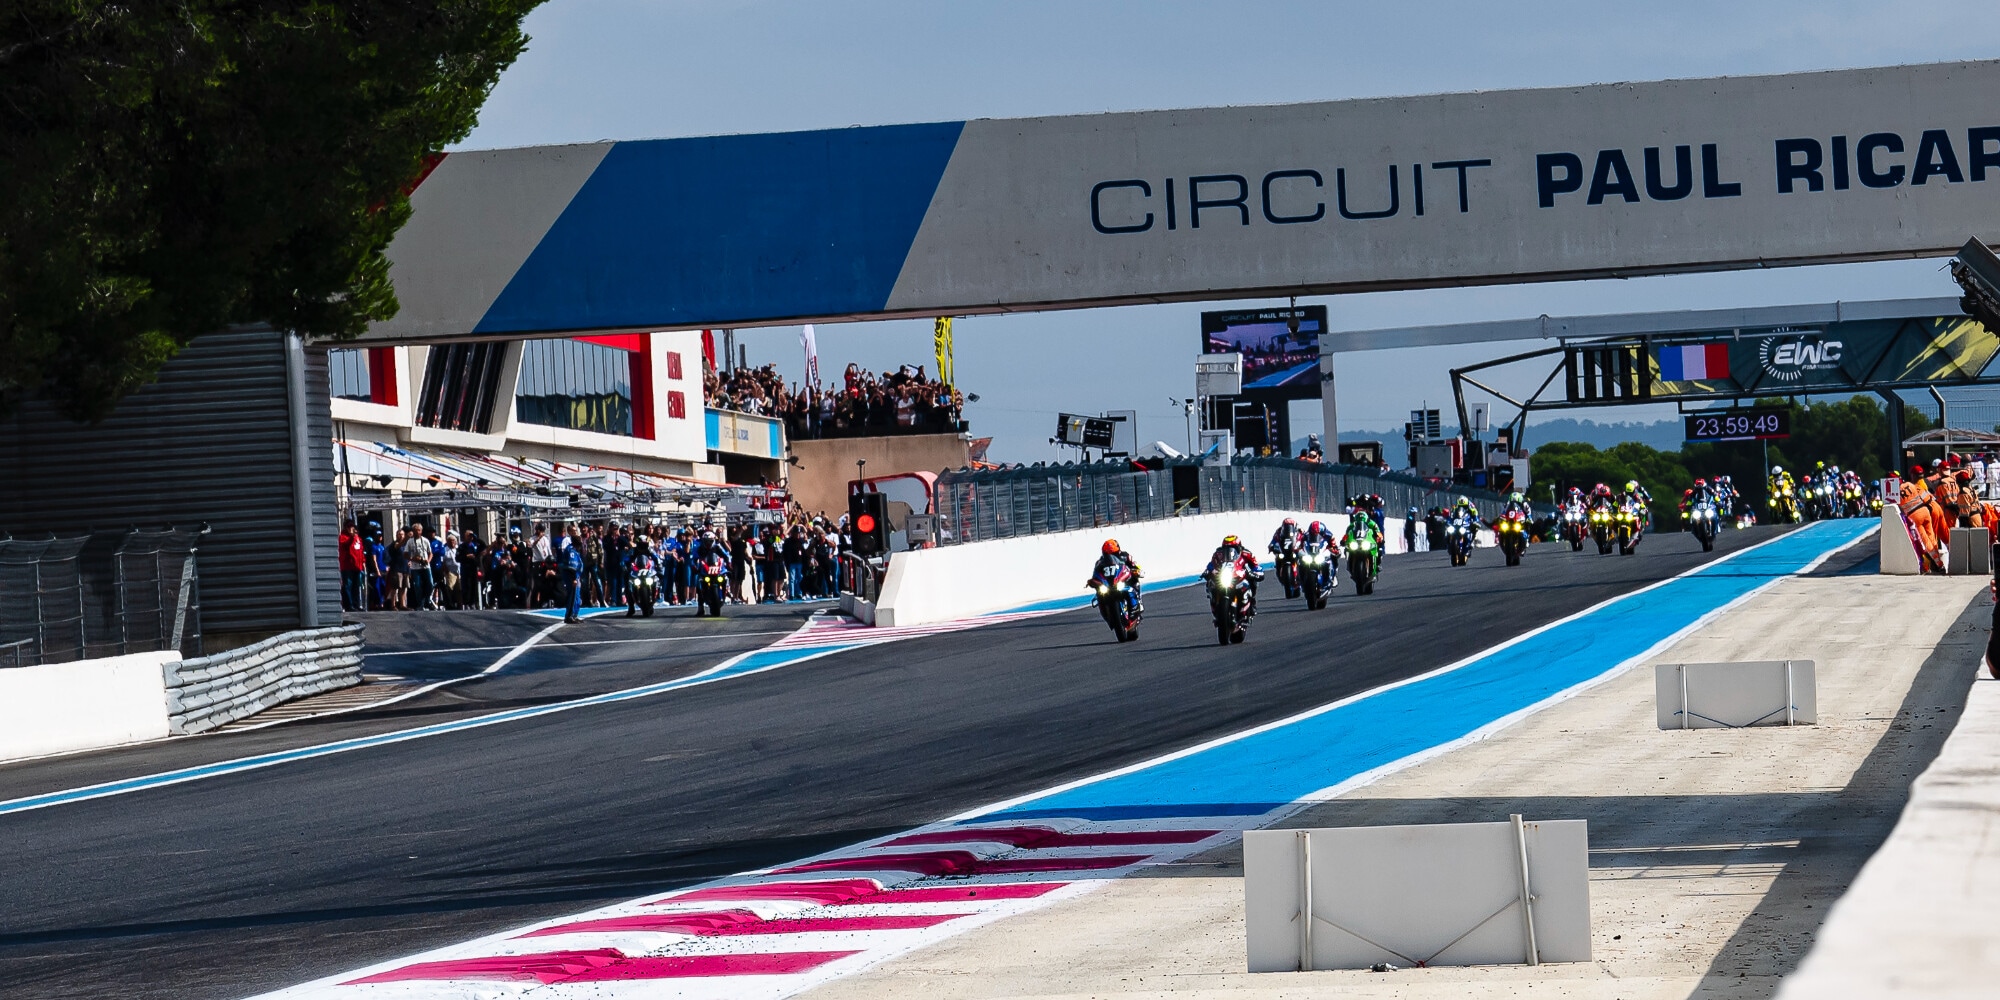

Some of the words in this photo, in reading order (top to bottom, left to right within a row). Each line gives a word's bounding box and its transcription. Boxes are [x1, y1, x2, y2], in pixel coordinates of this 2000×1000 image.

[1090, 159, 1492, 234] CIRCUIT
[1536, 143, 1742, 208] PAUL
[1774, 126, 2000, 194] RICAR
[1774, 340, 1843, 365] EWC
[1696, 414, 1779, 436] 23:59:49
[1283, 538, 1292, 550] 7
[1103, 565, 1117, 577] 37
